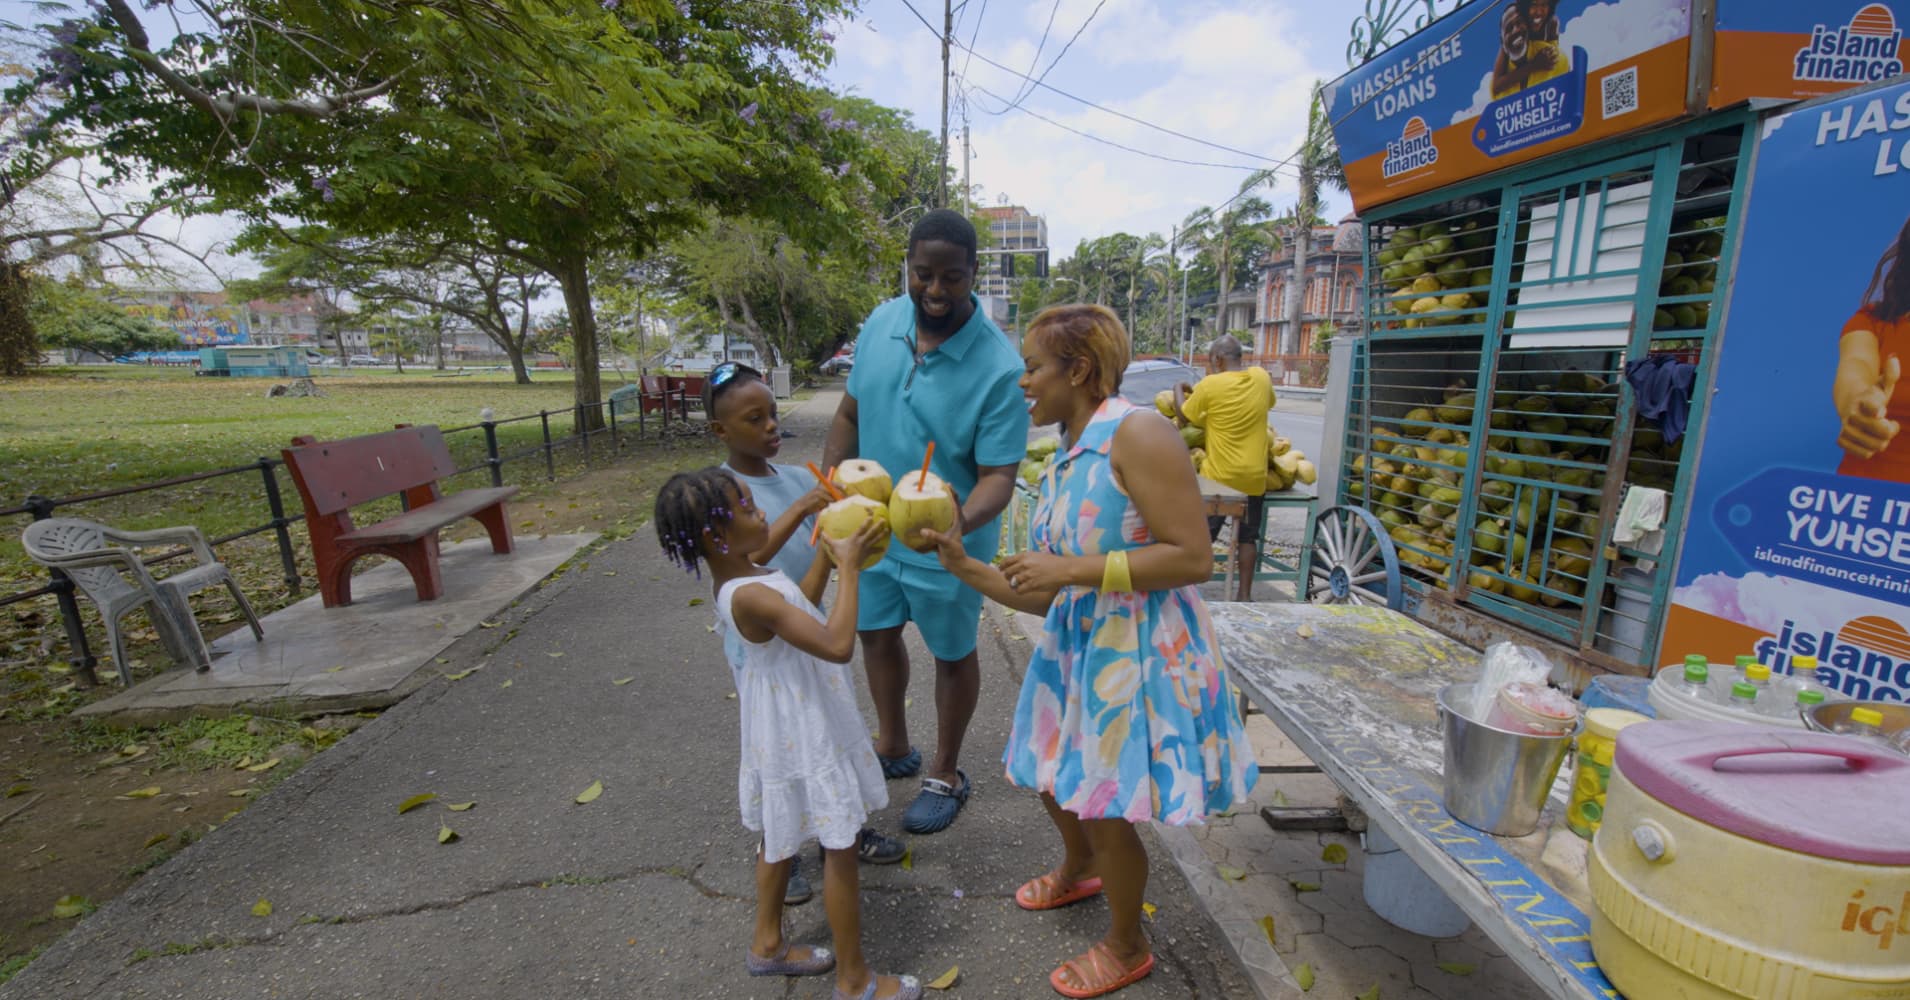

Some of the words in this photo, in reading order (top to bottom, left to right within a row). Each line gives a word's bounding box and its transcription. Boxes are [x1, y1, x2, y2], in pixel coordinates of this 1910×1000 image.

[1812, 27, 1900, 58] island
[1351, 34, 1462, 106] HASSLE-FREE
[1796, 50, 1900, 81] finance
[1374, 75, 1437, 120] LOANS
[1495, 100, 1522, 120] GIVE
[1526, 94, 1536, 109] IT
[1539, 88, 1556, 104] TO
[1496, 93, 1565, 136] YUHSELF!
[1388, 129, 1430, 160] island
[1384, 147, 1437, 176] finance
[1789, 485, 1872, 519] GIVE
